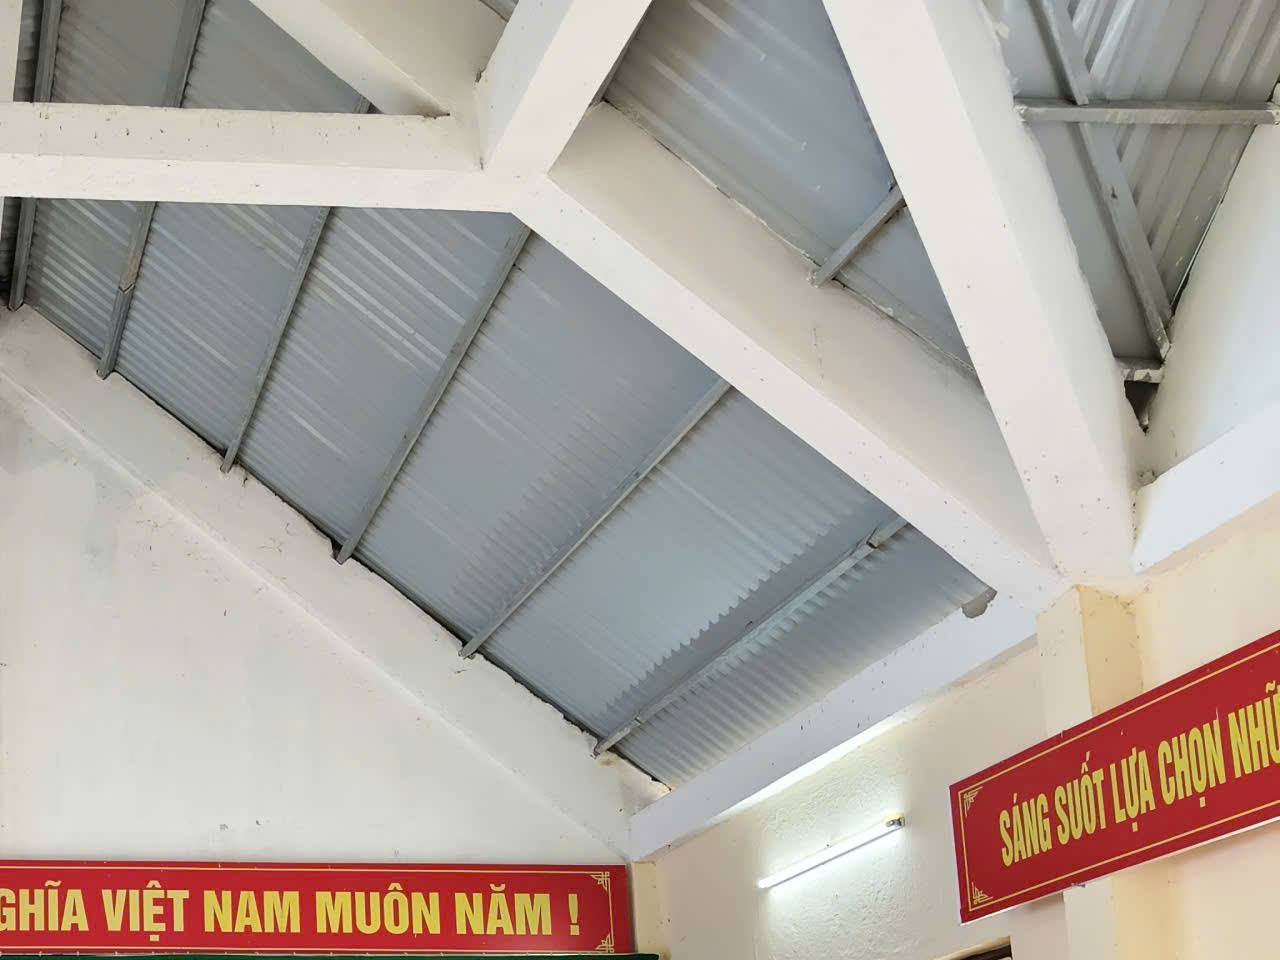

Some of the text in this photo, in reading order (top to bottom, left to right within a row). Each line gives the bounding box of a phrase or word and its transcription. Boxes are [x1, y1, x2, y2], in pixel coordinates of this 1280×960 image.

[999, 793, 1053, 867] SÁNG
[1054, 751, 1106, 845] SUỐT
[1110, 747, 1157, 832] LỰA
[1158, 719, 1227, 808] CHỌN
[102, 881, 191, 942] VIỆT
[204, 891, 301, 934] NAM
[315, 882, 441, 936] MUÔN
[454, 883, 552, 936] NĂM
[568, 893, 581, 937] !
